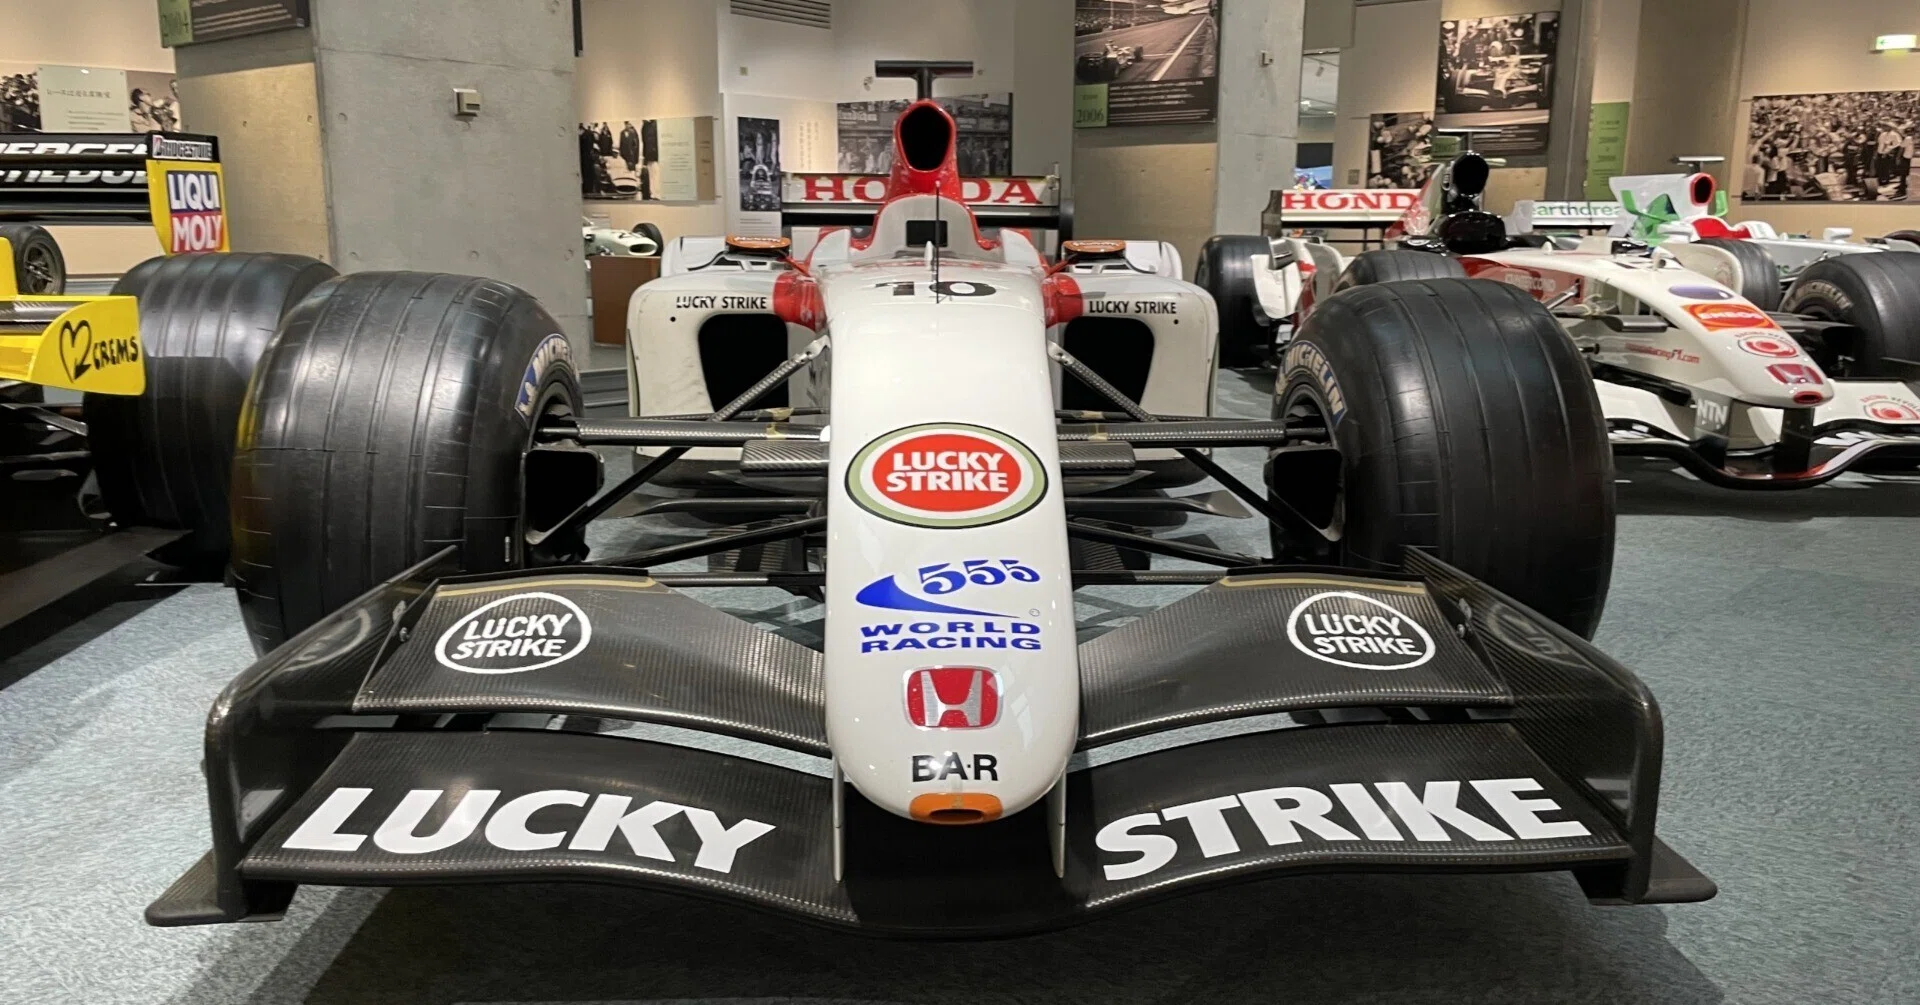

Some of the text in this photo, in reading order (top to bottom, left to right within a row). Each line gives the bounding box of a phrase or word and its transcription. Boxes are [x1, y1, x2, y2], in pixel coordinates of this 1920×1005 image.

[167, 173, 220, 211] LIQUI
[800, 175, 1042, 204] HODA
[1282, 192, 1419, 210] HOND
[171, 215, 223, 252] MOLY
[676, 296, 767, 309] LUCKY STRIKE
[1089, 301, 1177, 314] LUCKY STRIKE
[893, 451, 1004, 471] LUCKY
[886, 472, 1009, 493] STRIKE
[918, 559, 1041, 595] 555
[463, 613, 573, 641] LUCKY
[861, 621, 1041, 638] WORLD
[1304, 613, 1402, 637] LUCKY
[451, 638, 567, 660] STRIKE
[861, 637, 1042, 653] RACING
[1313, 636, 1423, 656] STRIKE
[282, 787, 776, 873] LUCKY
[1095, 777, 1592, 881] STRIKE
